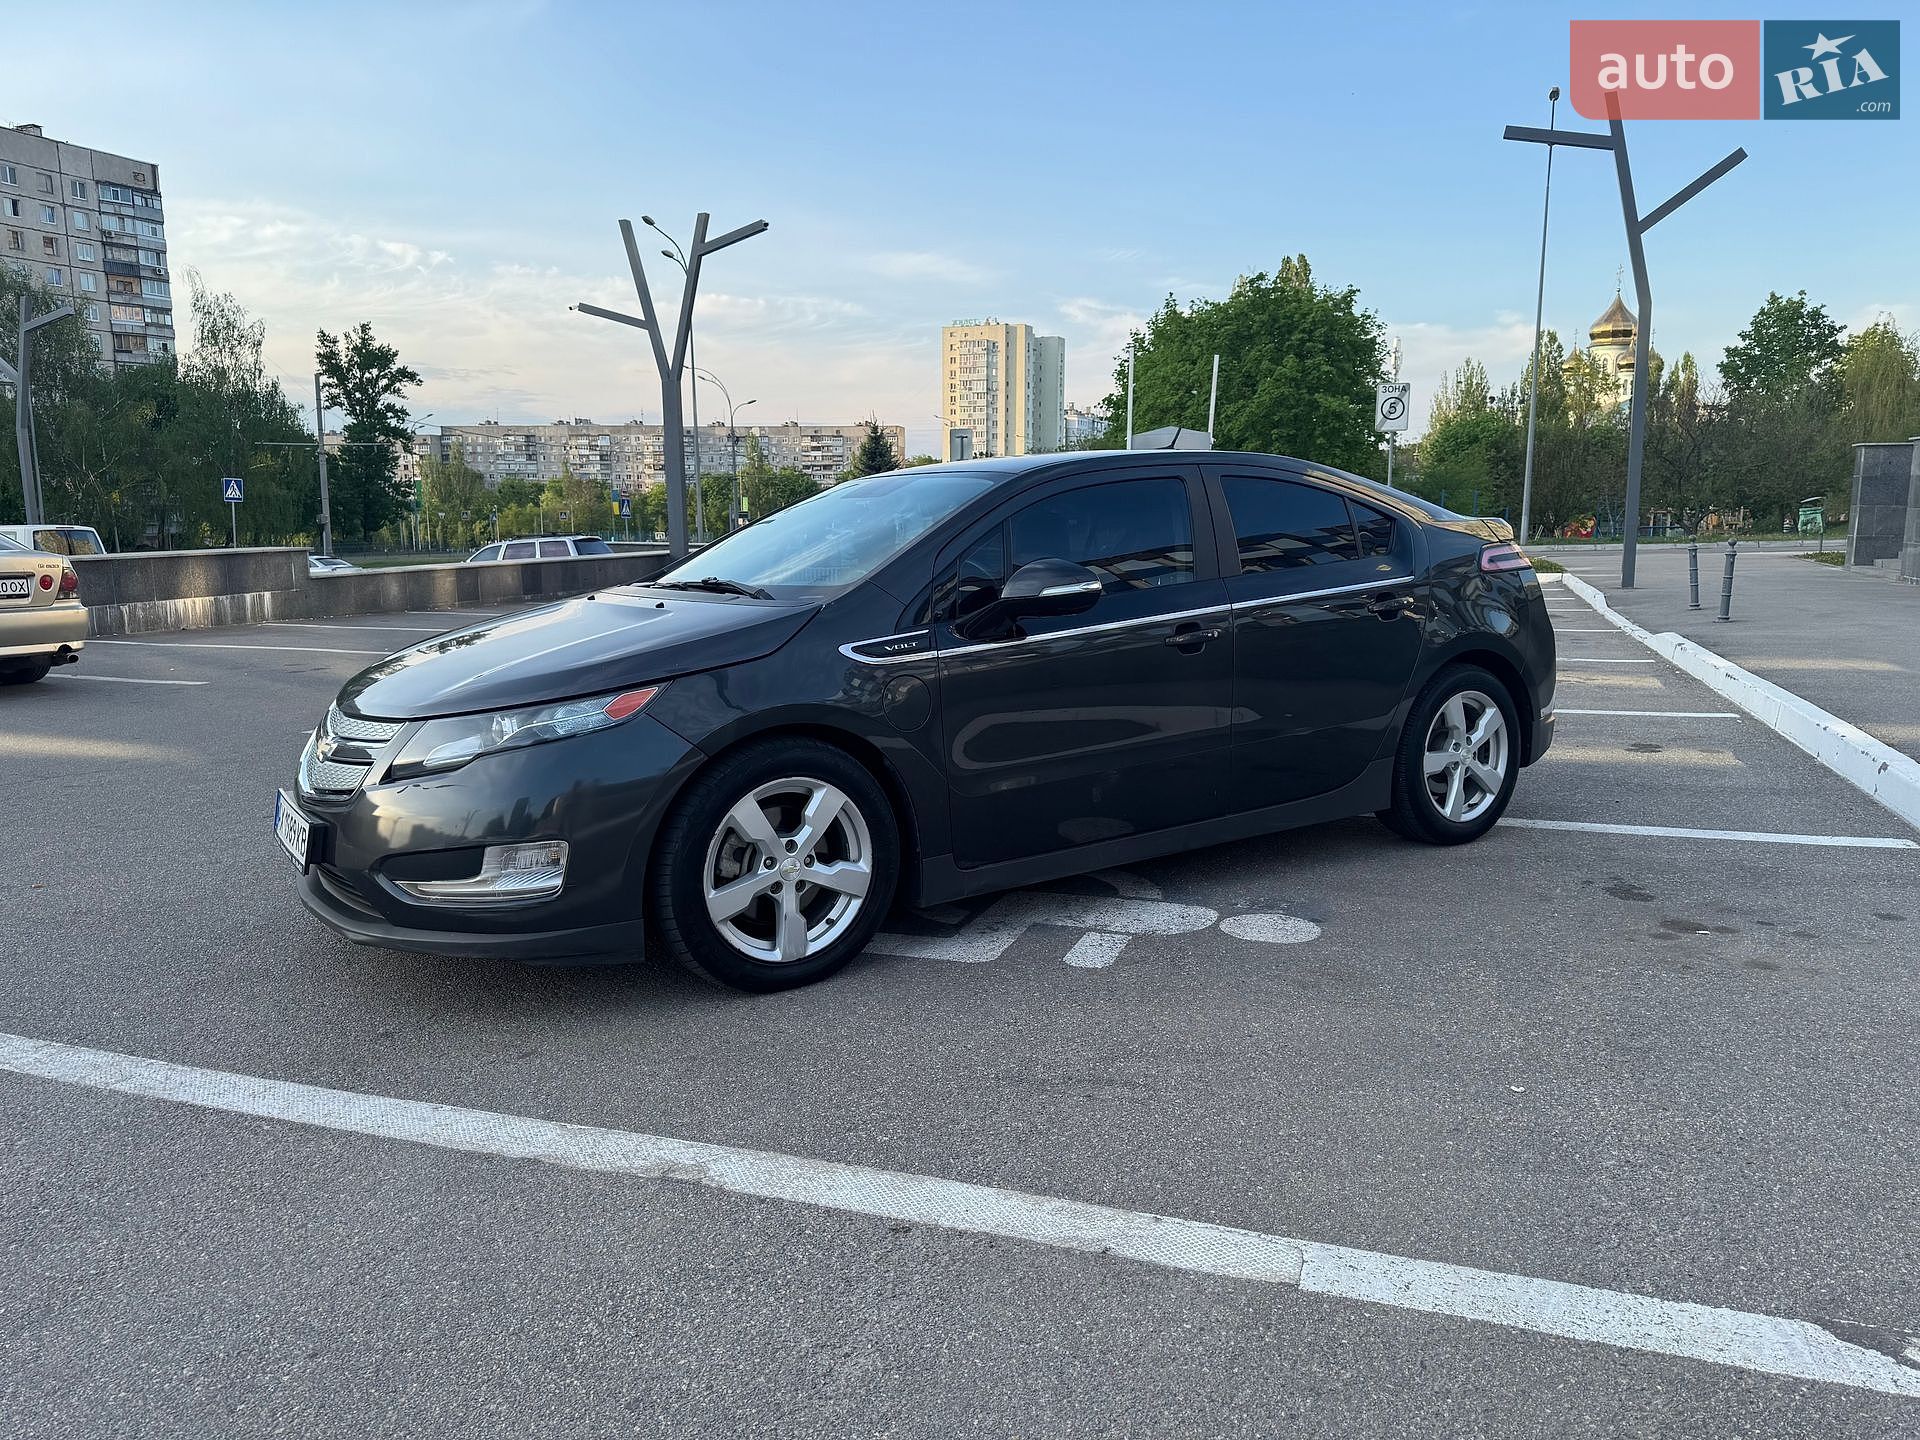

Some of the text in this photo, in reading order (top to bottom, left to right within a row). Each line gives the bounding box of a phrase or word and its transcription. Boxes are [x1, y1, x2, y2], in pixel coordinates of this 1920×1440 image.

[1382, 385, 1407, 393] ЗОНА
[1388, 402, 1397, 414] 5
[884, 642, 918, 651] VOLT
